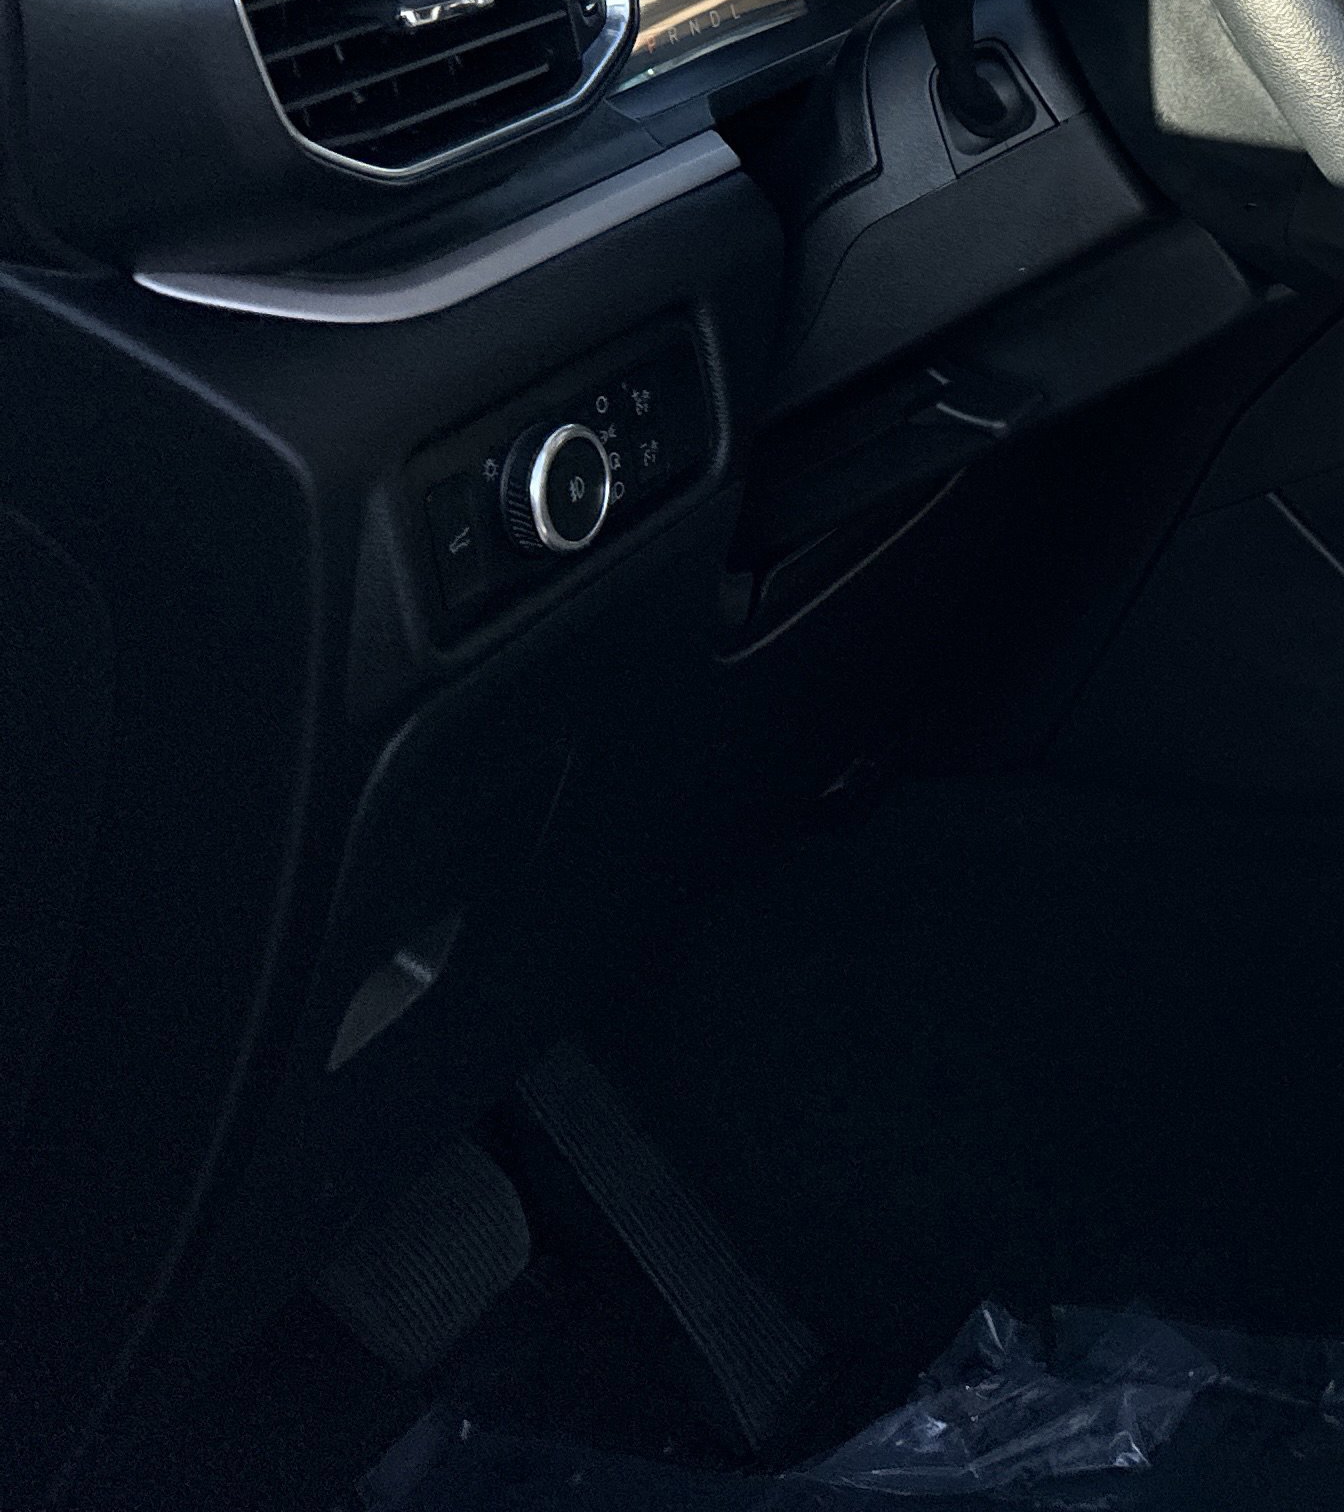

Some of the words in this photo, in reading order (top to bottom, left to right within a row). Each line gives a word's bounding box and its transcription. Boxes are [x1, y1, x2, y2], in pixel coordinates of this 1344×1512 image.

[667, 27, 679, 45] R
[689, 19, 701, 36] N
[709, 10, 721, 28] D
[730, 3, 742, 20] L
